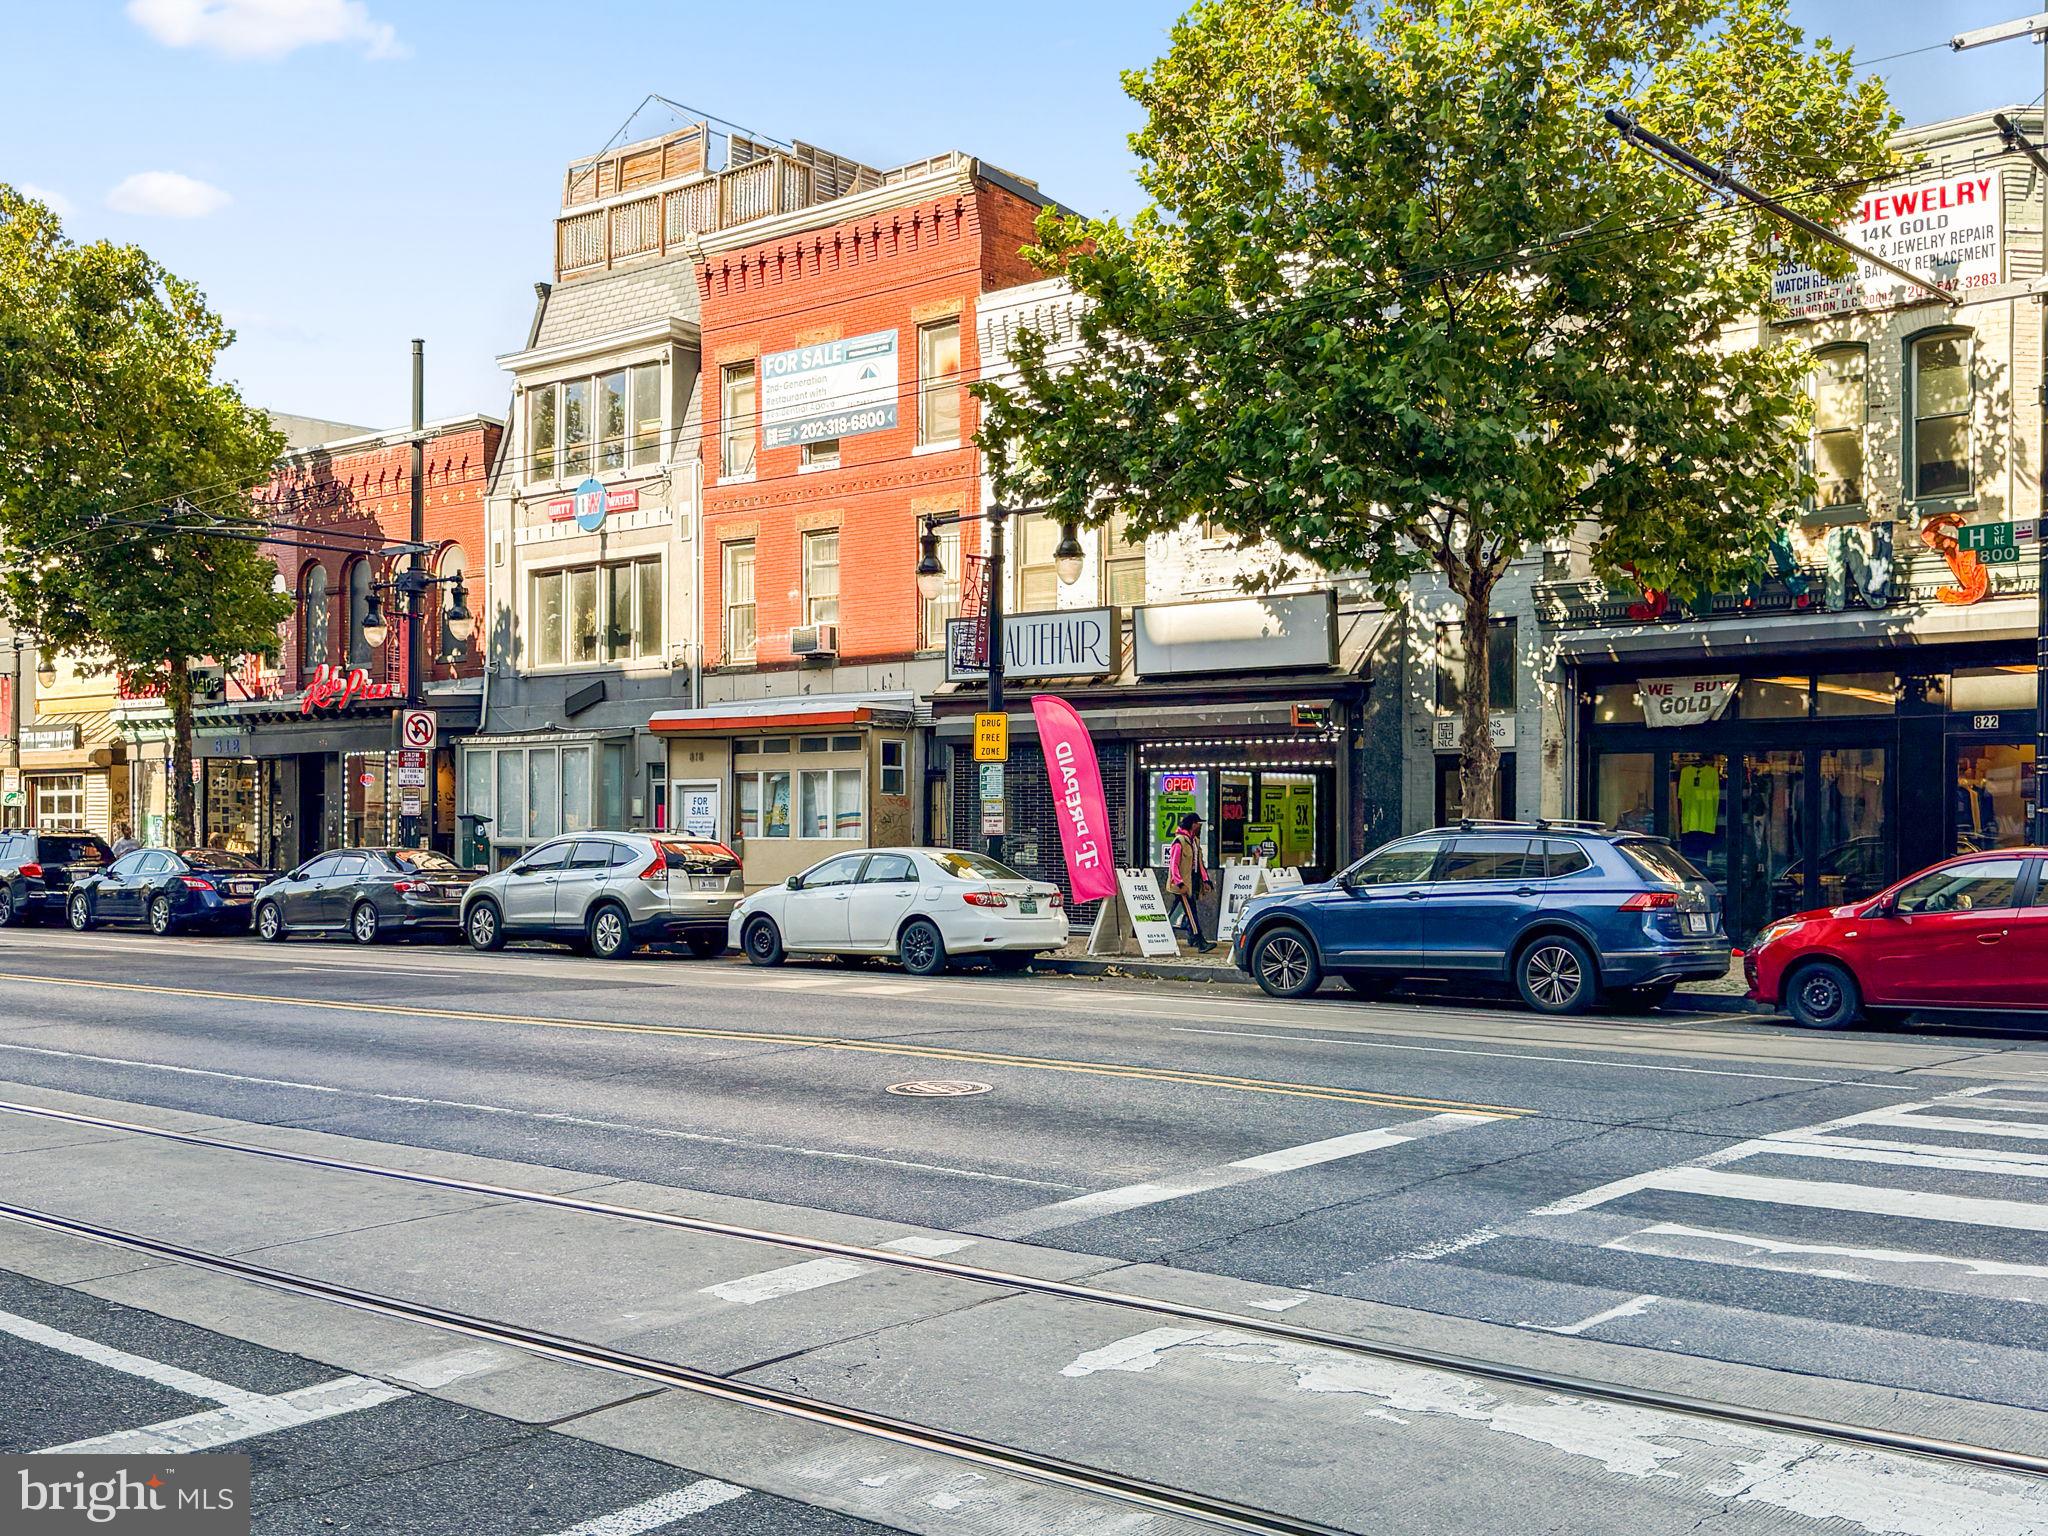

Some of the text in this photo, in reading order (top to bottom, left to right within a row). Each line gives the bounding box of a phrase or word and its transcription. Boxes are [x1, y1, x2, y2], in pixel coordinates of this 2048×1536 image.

[1859, 177, 1992, 225] JEWELRY
[1861, 225, 1892, 242] 14K
[1900, 214, 1949, 236] GOLD
[1879, 244, 1887, 257] &
[1892, 233, 1946, 256] JEWELRY
[1950, 224, 1994, 246] REPAIR
[1776, 276, 1810, 295] WATCH
[1915, 243, 1997, 271] REPLACEMENT
[765, 355, 798, 376] FOR
[801, 343, 841, 369] SALE
[766, 387, 827, 406] Restaurant with
[800, 409, 886, 440] 202-318-6800
[549, 491, 635, 517] DIRTY DW WATER
[1969, 525, 2005, 547] H ST
[1994, 536, 2005, 545] NE
[1980, 548, 2015, 562] 800
[1004, 619, 1110, 667] AUTEHAIR
[1648, 680, 1731, 696] WE BUY
[1660, 696, 1711, 715] GOLD
[981, 719, 1001, 727] DRUG
[1975, 716, 1998, 728] 822
[981, 733, 1000, 741] FREE
[981, 747, 1000, 756] ZONE
[1164, 778, 1196, 792] OPEN
[691, 806, 709, 815] SALE
[693, 797, 708, 806] FOR
[1296, 804, 1309, 826] 3X
